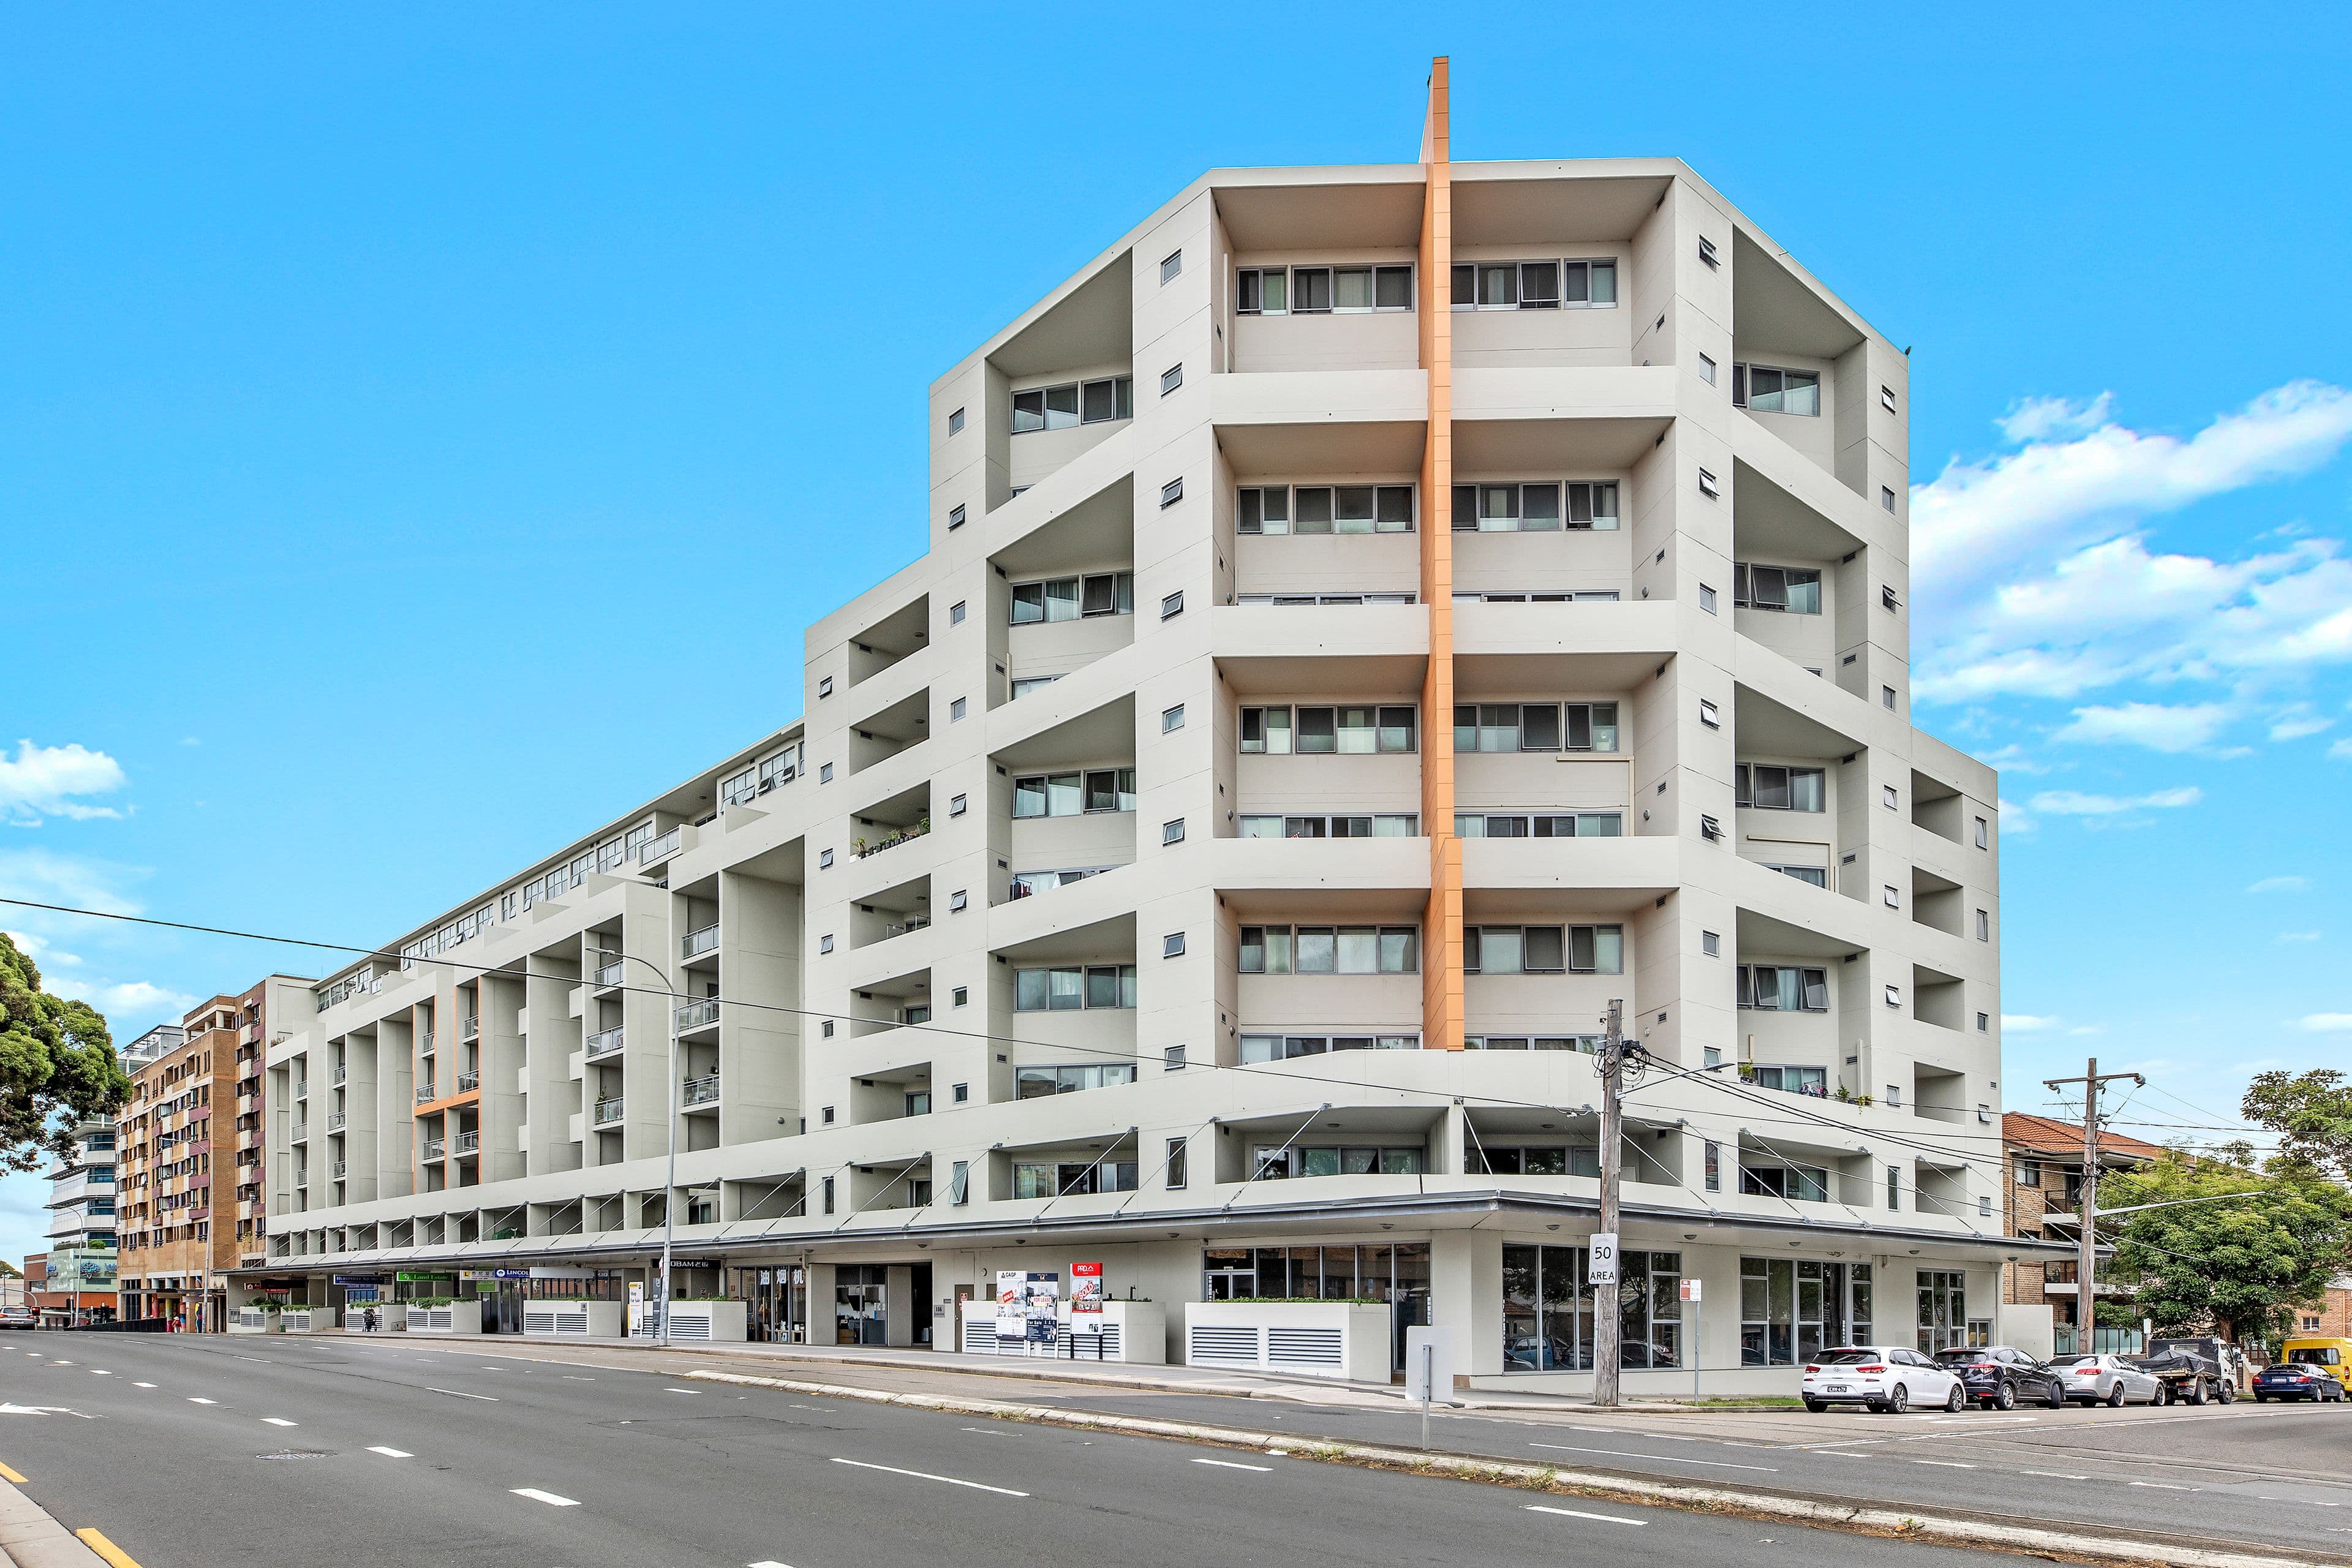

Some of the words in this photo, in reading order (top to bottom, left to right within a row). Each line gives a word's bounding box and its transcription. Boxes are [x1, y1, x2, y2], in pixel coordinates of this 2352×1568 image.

[1594, 1246, 1611, 1259] 50
[1589, 1271, 1615, 1280] AREA
[1079, 1283, 1094, 1299] SOLD
